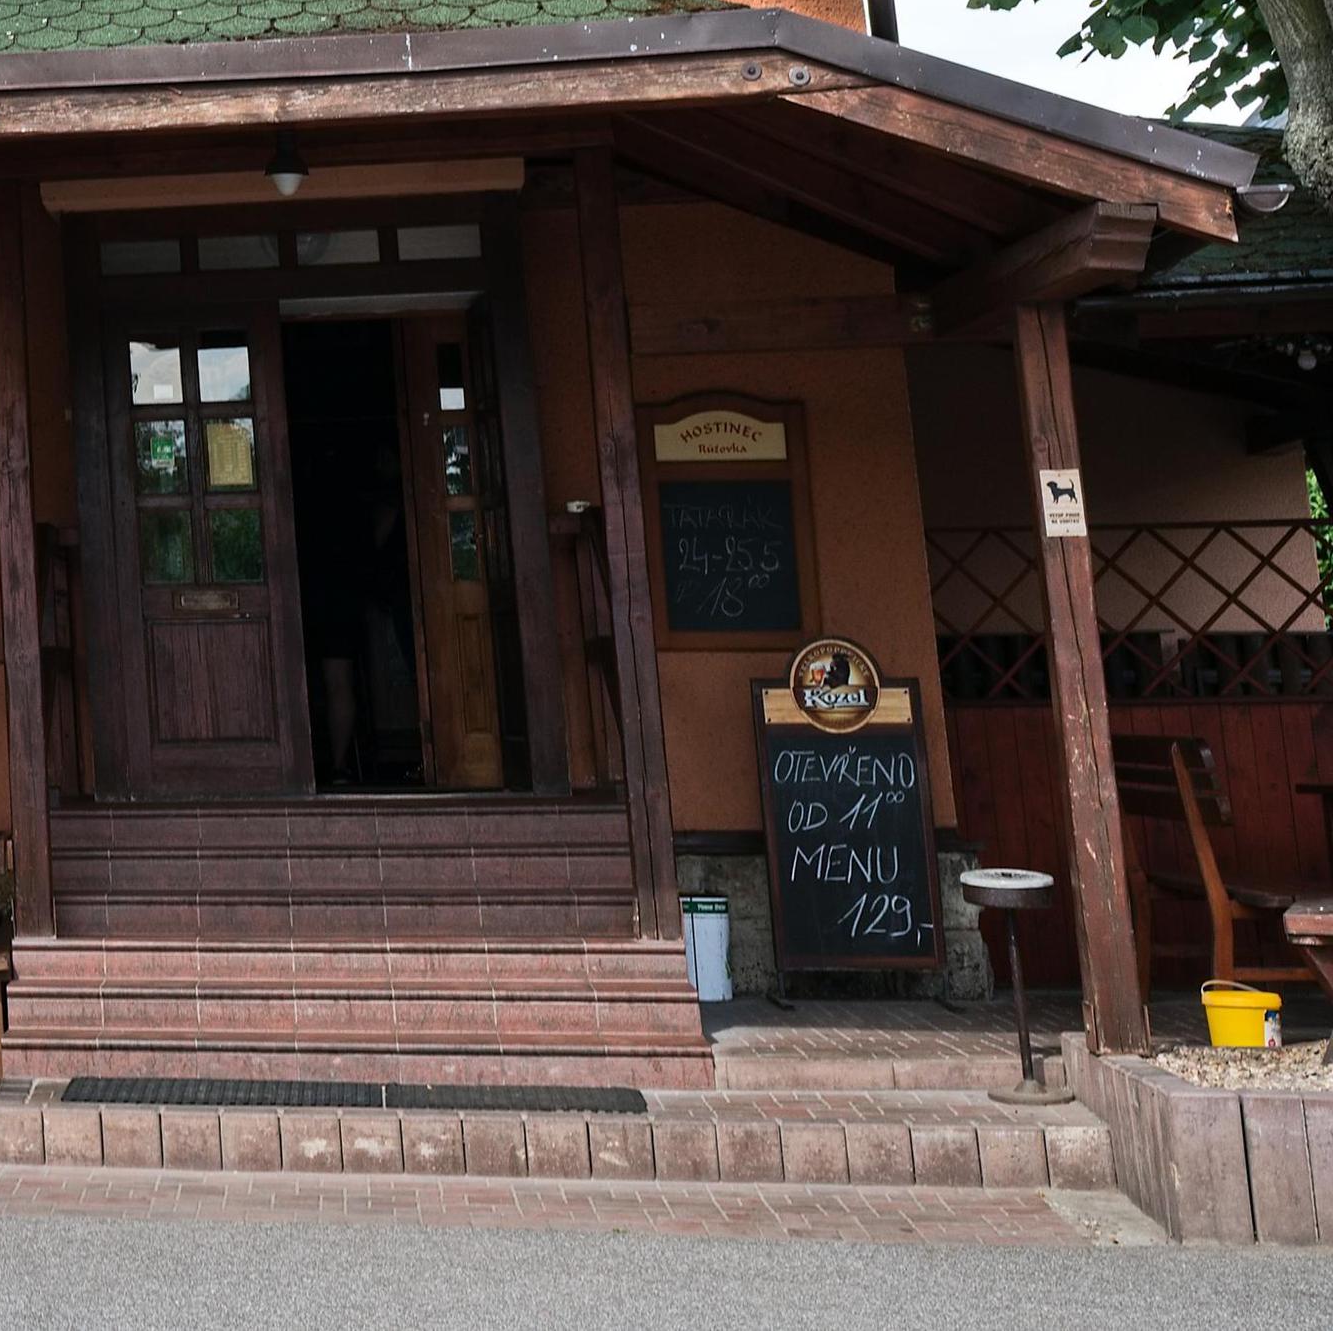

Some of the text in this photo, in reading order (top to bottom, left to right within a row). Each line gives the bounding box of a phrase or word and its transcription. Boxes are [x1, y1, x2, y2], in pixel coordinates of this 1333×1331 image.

[679, 421, 763, 443] HOSTINEC
[804, 687, 870, 709] Kozel
[774, 745, 916, 789] OTEVŘENO
[787, 799, 829, 834] OD
[790, 843, 900, 885] MENU
